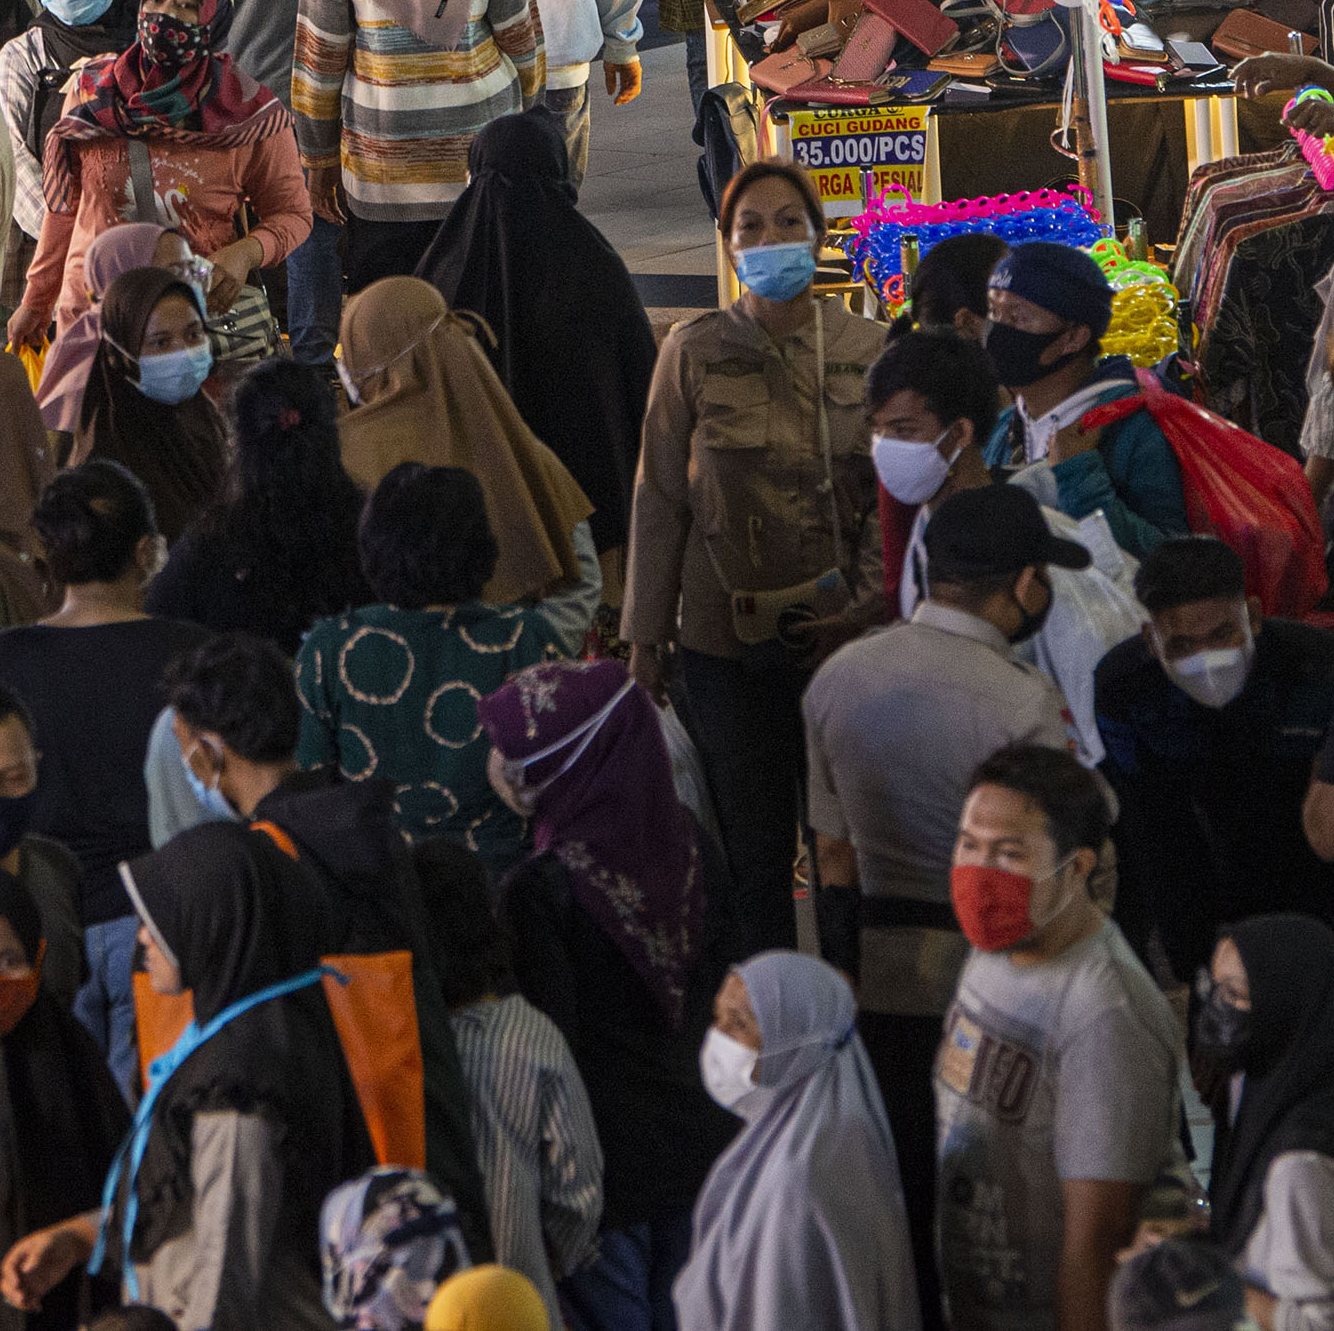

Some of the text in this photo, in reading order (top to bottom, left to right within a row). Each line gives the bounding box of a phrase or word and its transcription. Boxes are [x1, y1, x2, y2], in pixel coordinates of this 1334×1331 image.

[798, 117, 921, 136] CUCI GUDANG
[797, 135, 924, 166] 35.000/PCS
[812, 173, 854, 196] RGA
